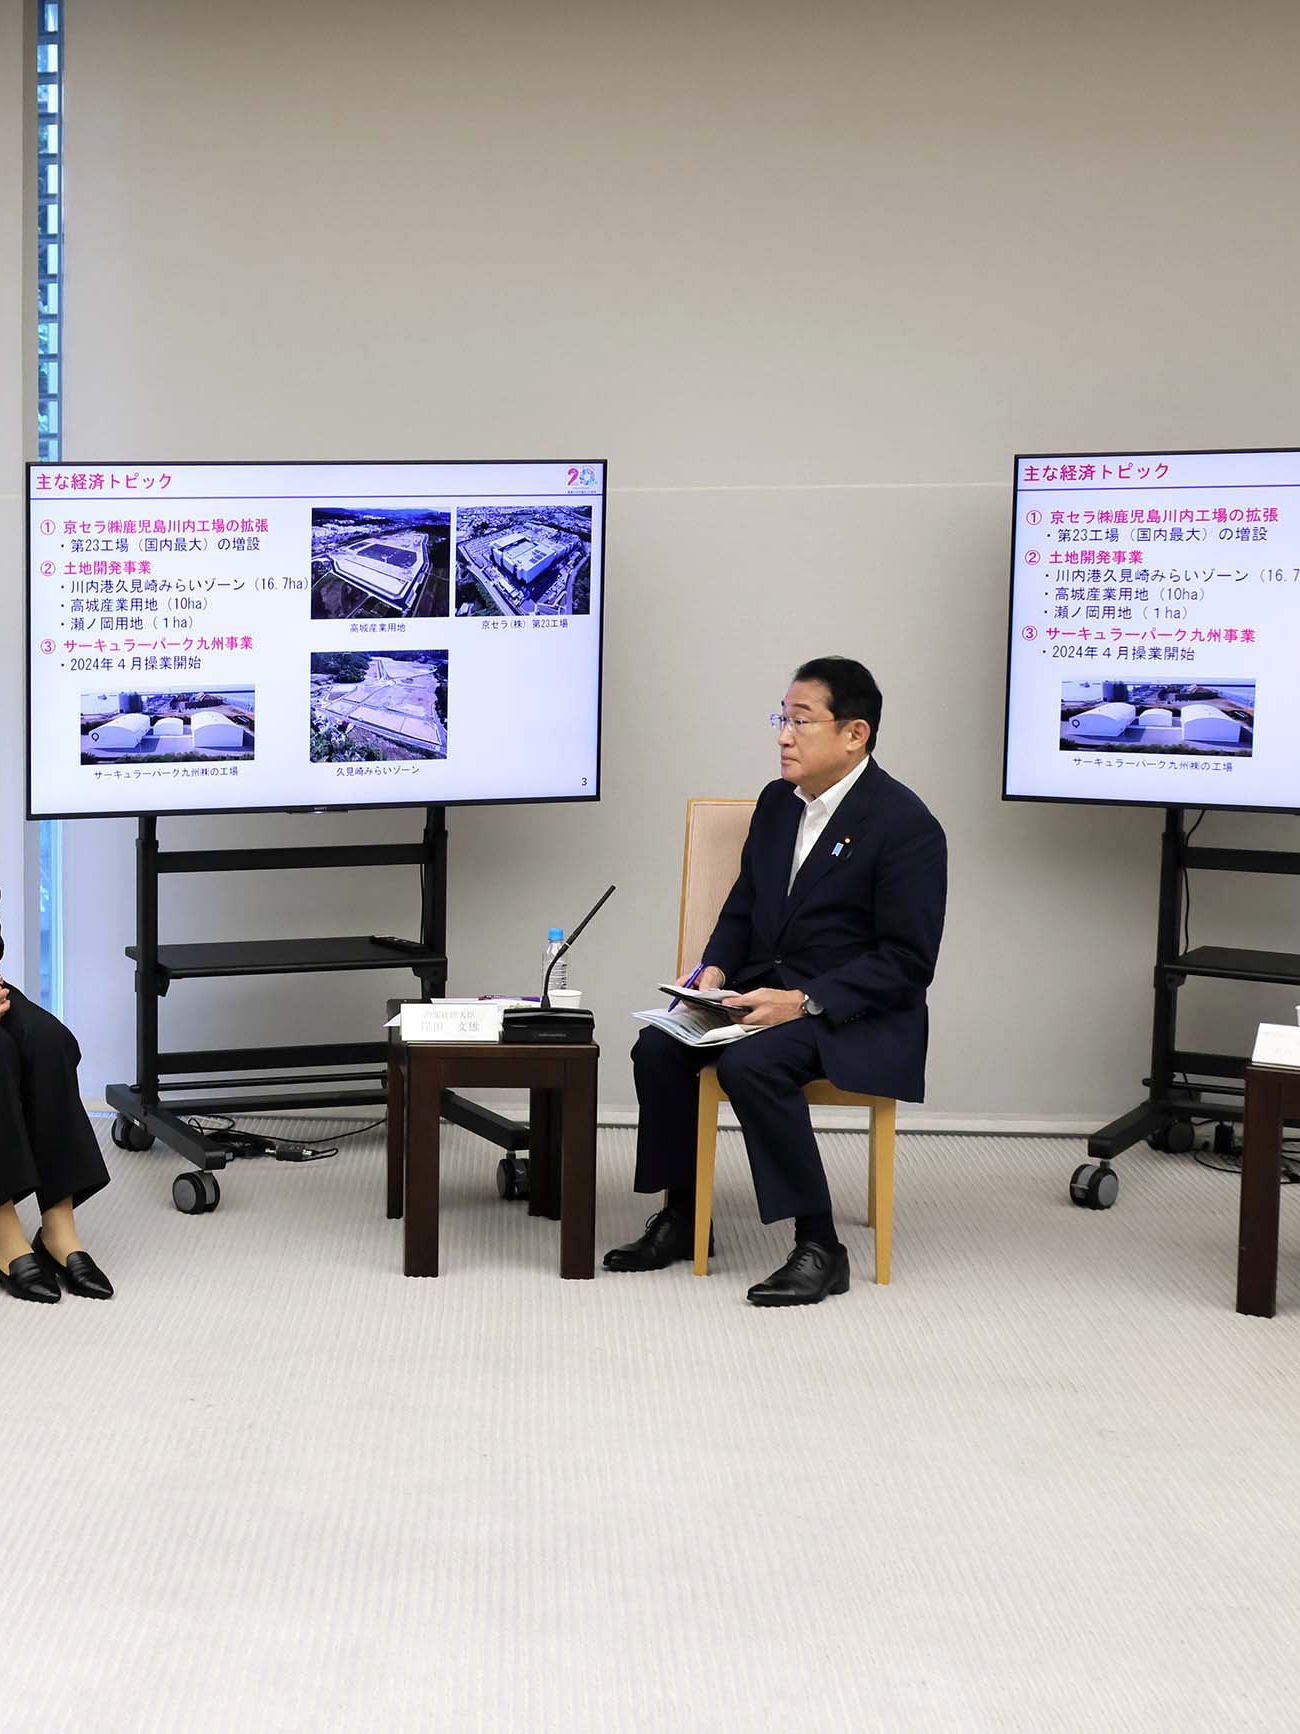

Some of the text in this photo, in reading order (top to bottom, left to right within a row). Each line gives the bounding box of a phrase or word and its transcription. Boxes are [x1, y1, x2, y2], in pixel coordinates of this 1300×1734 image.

[1023, 462, 1170, 482] 主な経済トピック
[36, 472, 172, 490] 主な経済トピック
[1049, 550, 1143, 565] 土地開発事業
[63, 560, 152, 576] 土地開発事業
[1046, 626, 1256, 643] サーキュラーパーク九州事業
[63, 635, 253, 653] サーキュラーパーク九州事業
[336, 765, 420, 777] 久見崎みらいゾーン
[581, 777, 588, 786] 3
